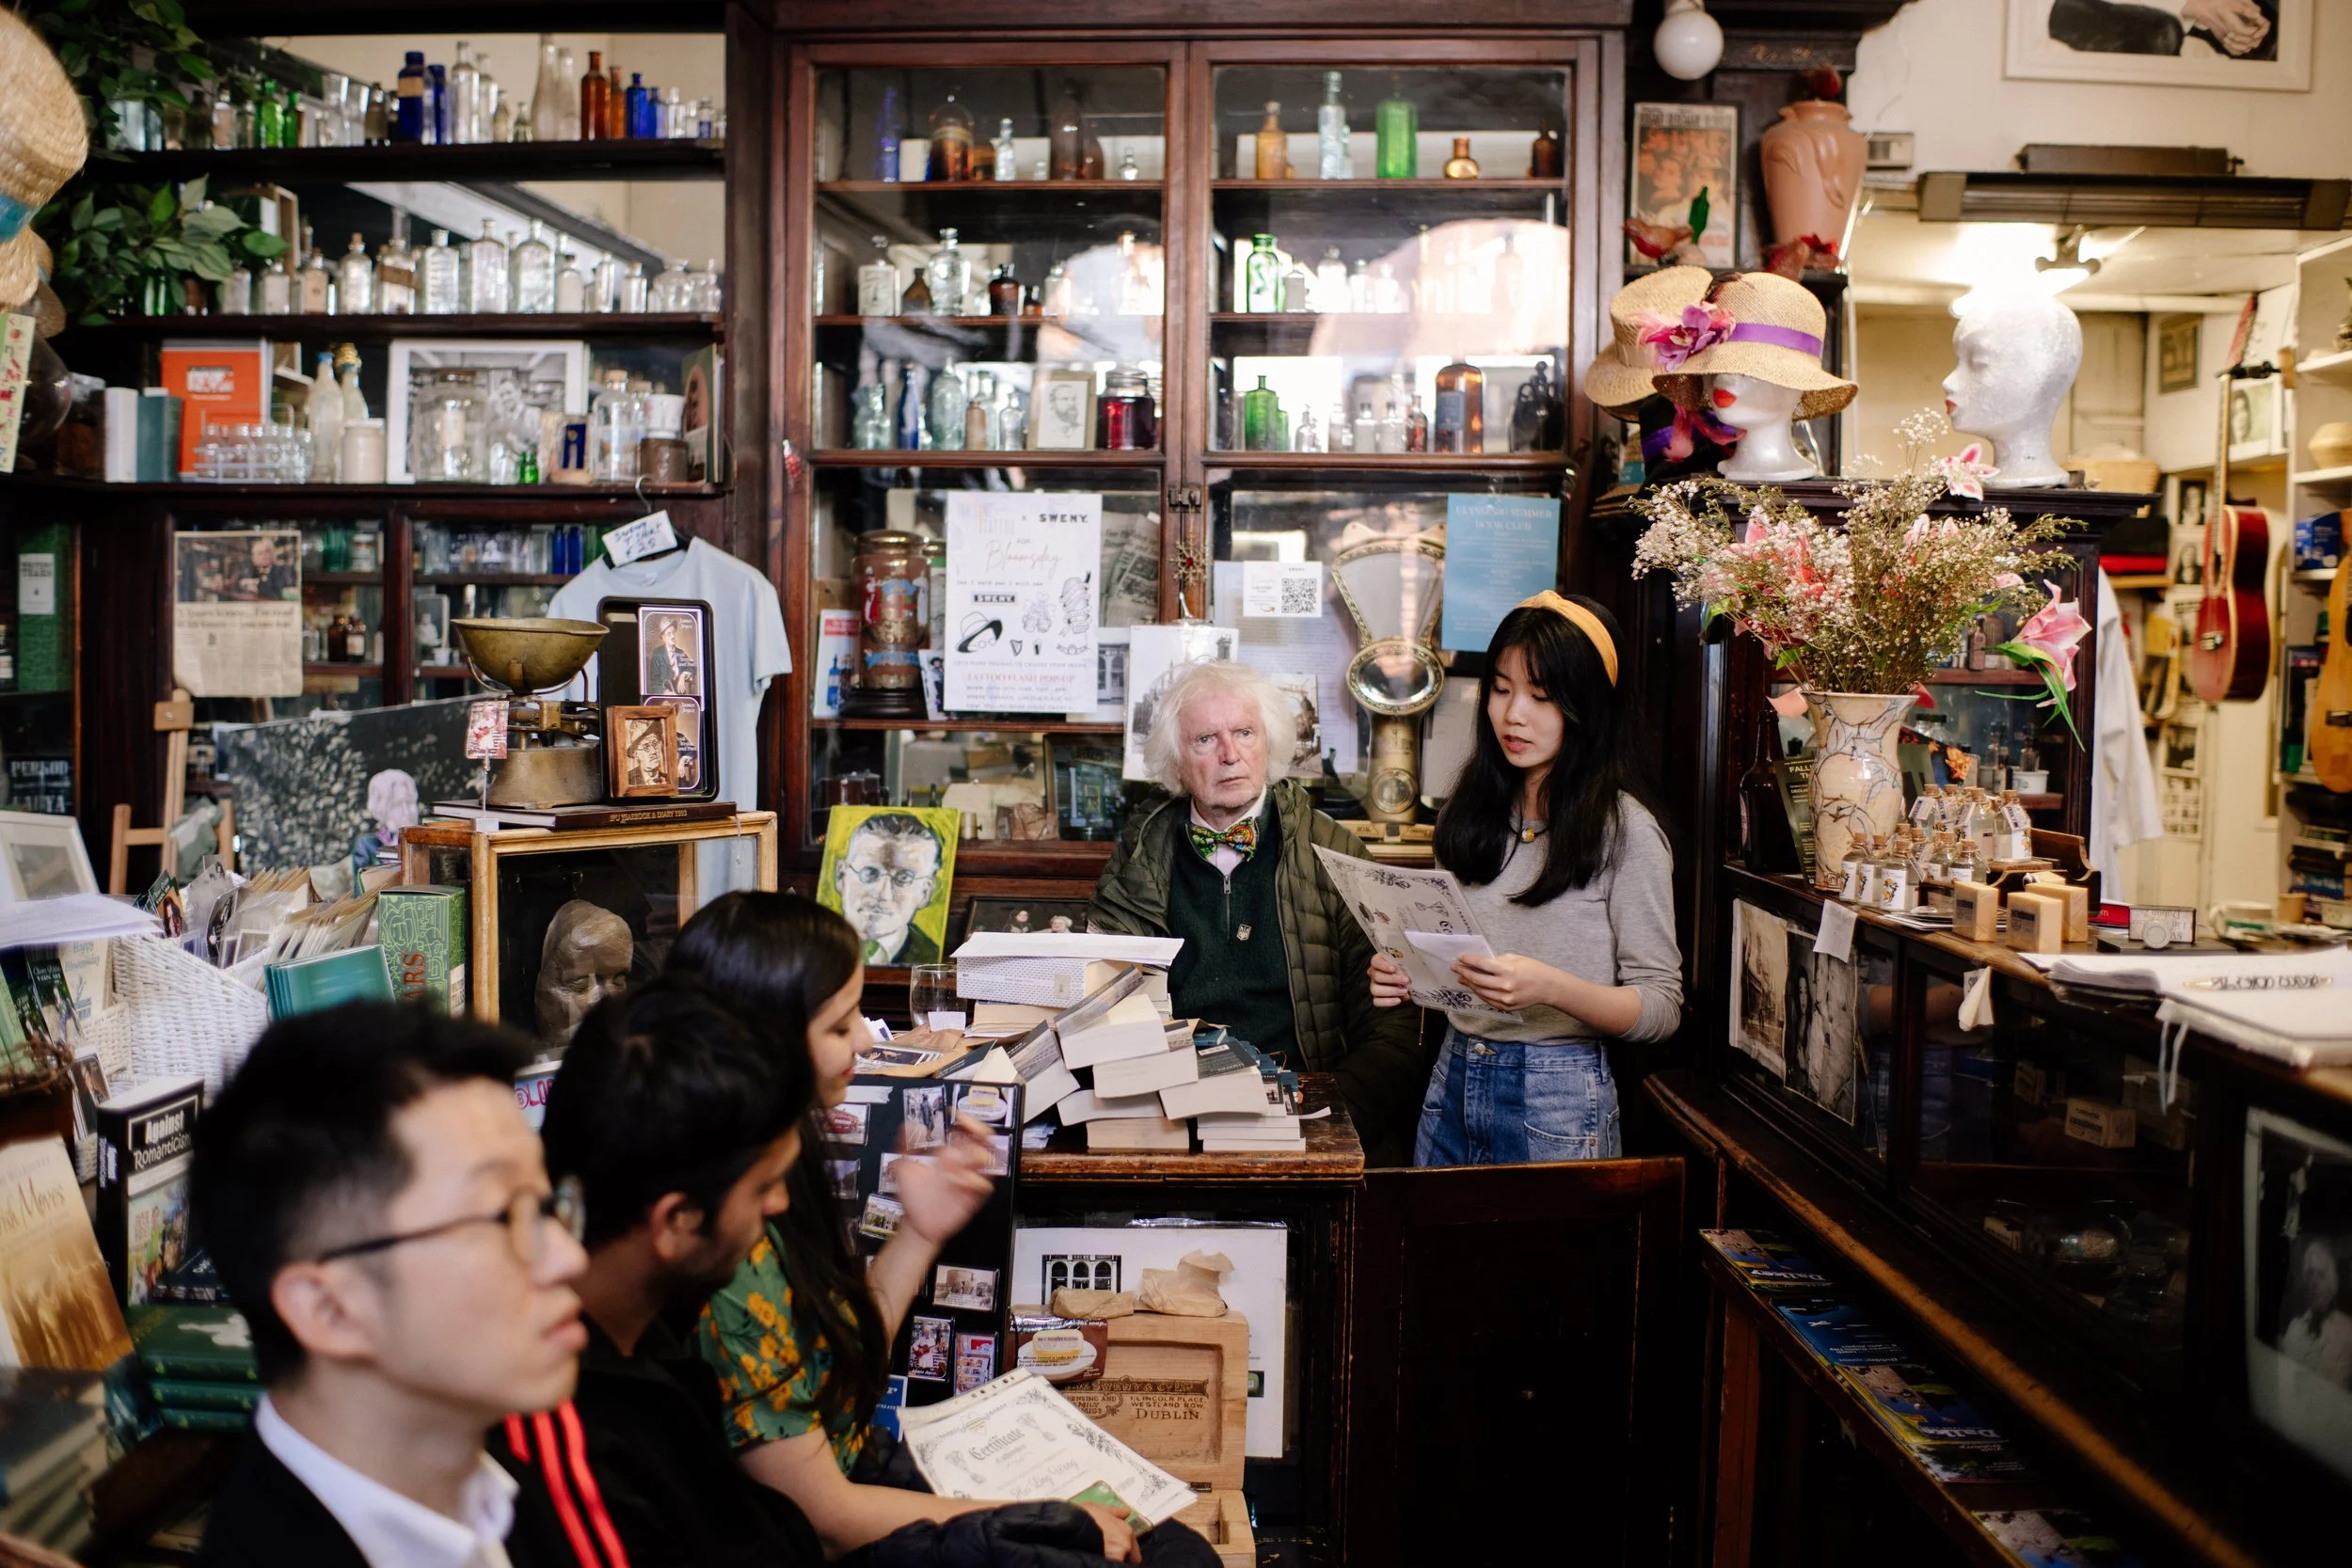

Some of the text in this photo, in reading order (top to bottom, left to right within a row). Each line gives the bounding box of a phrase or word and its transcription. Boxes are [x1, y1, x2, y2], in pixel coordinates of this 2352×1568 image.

[1475, 518, 1533, 531] BOOK CLUB
[986, 540, 1061, 579] Bloomsday
[967, 673, 1075, 683] TATTOO FLASH POP-UP
[621, 811, 651, 821] YEARBOOK
[658, 810, 674, 818] DIARY
[675, 809, 688, 817] 1993
[145, 1110, 184, 1145] Against
[134, 1133, 191, 1170] Romanticism
[1091, 1382, 1141, 1392] SWENY
[1143, 1383, 1153, 1392] &
[969, 1427, 1026, 1461] Certificate
